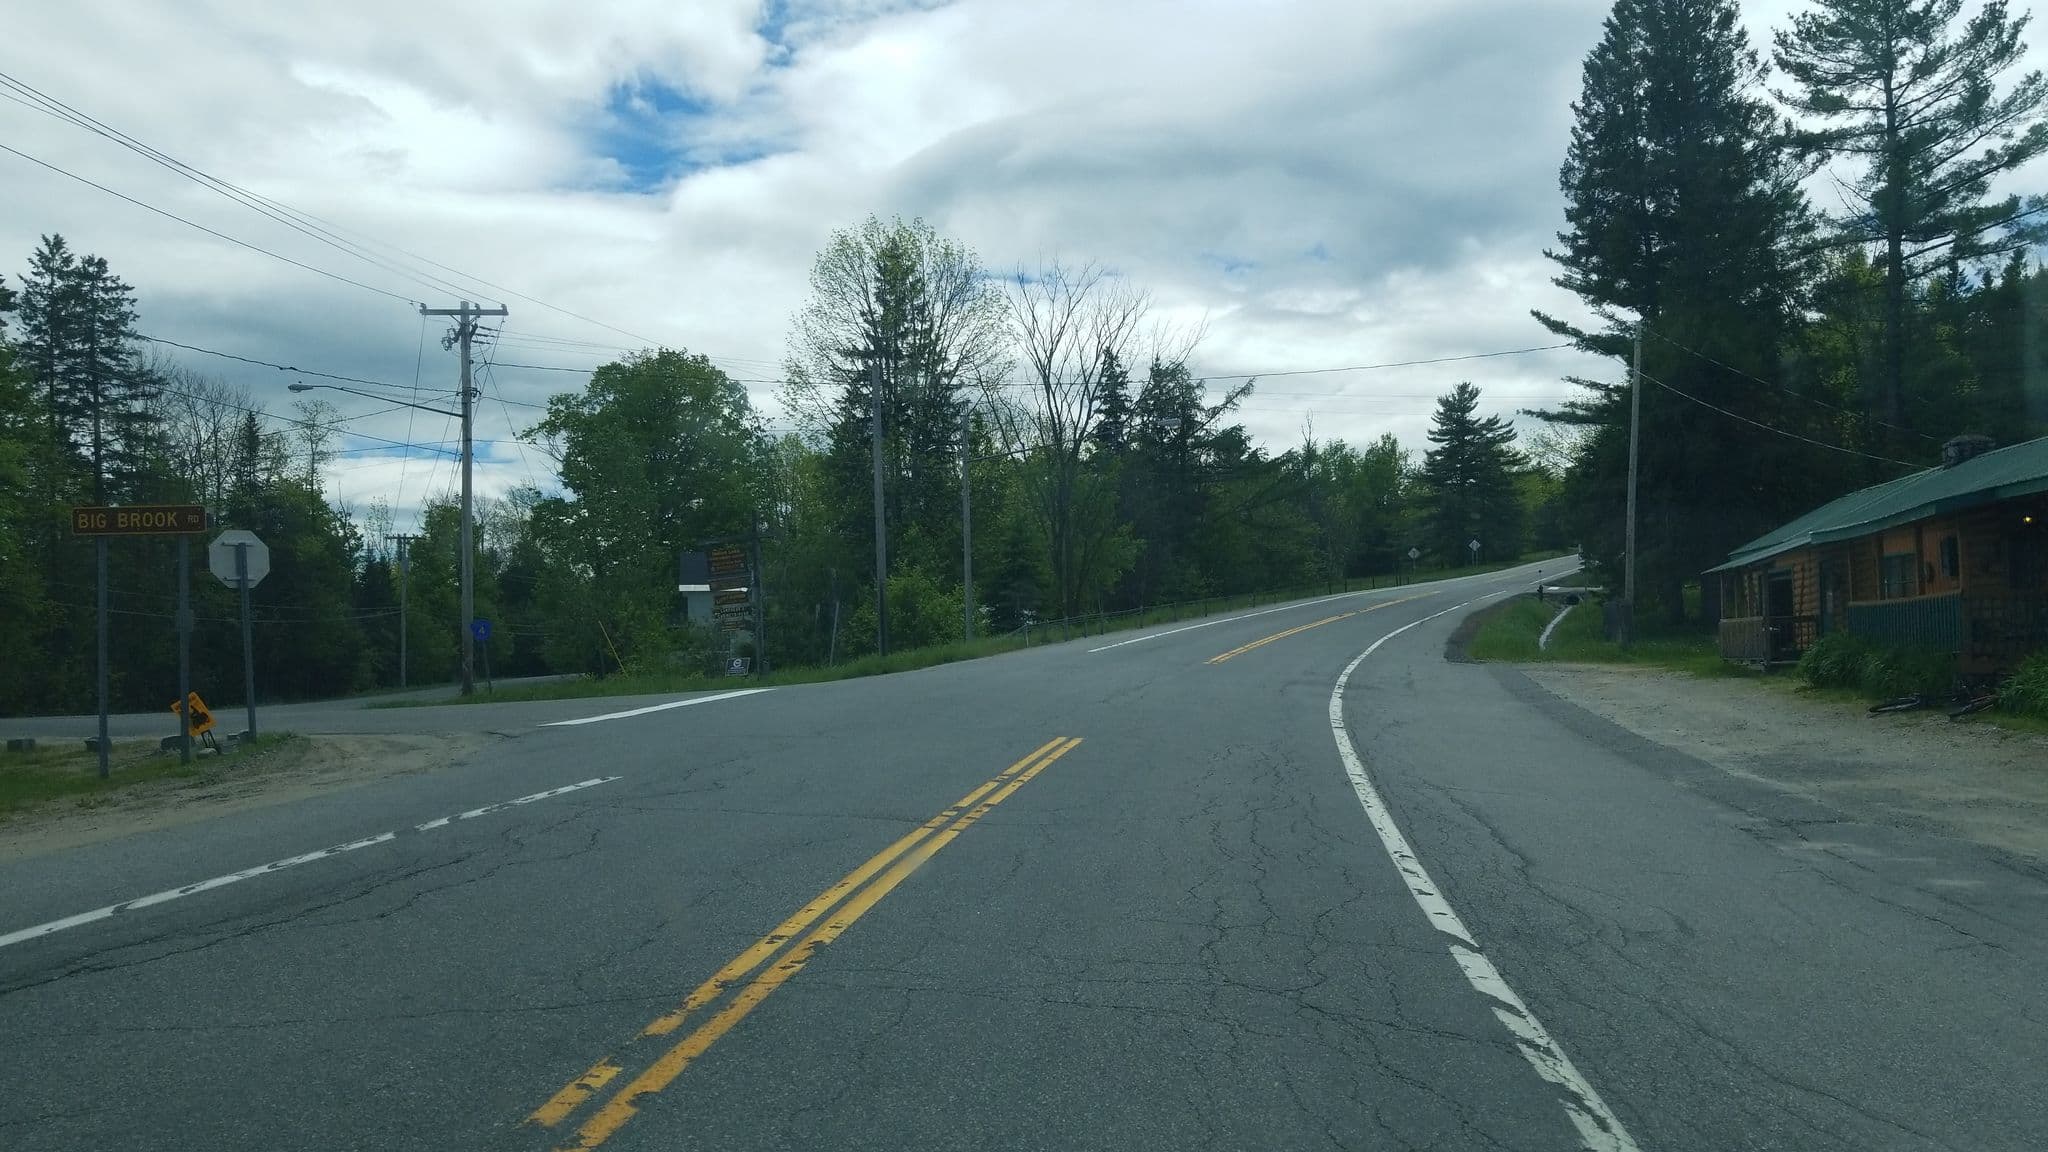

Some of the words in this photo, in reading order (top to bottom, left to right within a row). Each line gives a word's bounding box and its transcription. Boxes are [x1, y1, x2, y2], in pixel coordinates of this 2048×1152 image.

[78, 513, 107, 529] BIG
[117, 512, 178, 527] BROOK
[187, 514, 199, 523] RD
